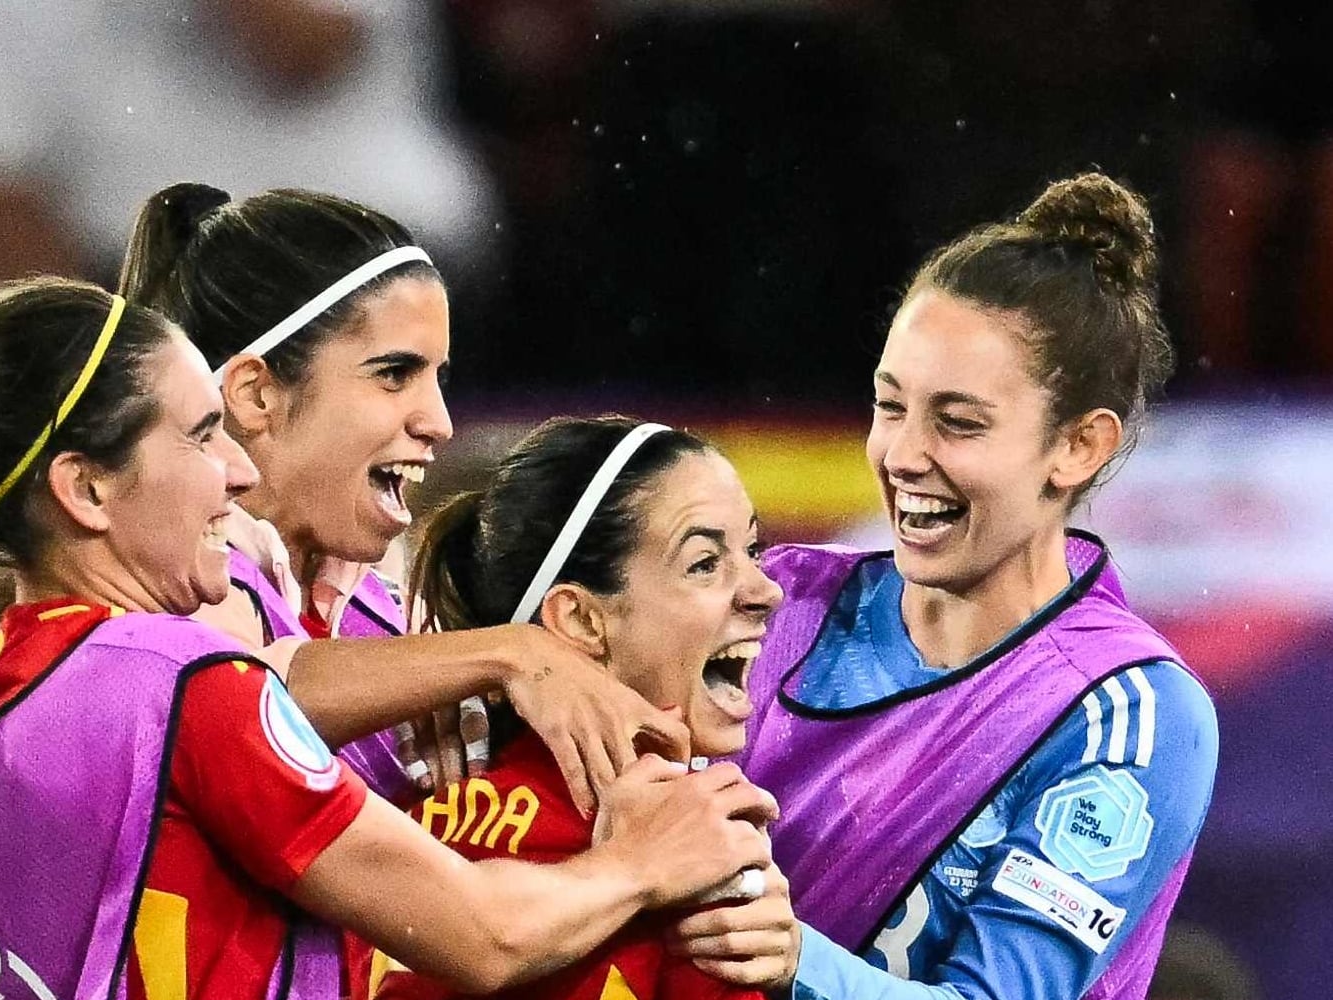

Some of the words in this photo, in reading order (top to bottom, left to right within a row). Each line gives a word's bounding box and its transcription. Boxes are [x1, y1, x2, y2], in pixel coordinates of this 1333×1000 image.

[1078, 797, 1096, 812] We
[1070, 822, 1112, 847] Strong
[1002, 864, 1088, 918] FOUNDATION
